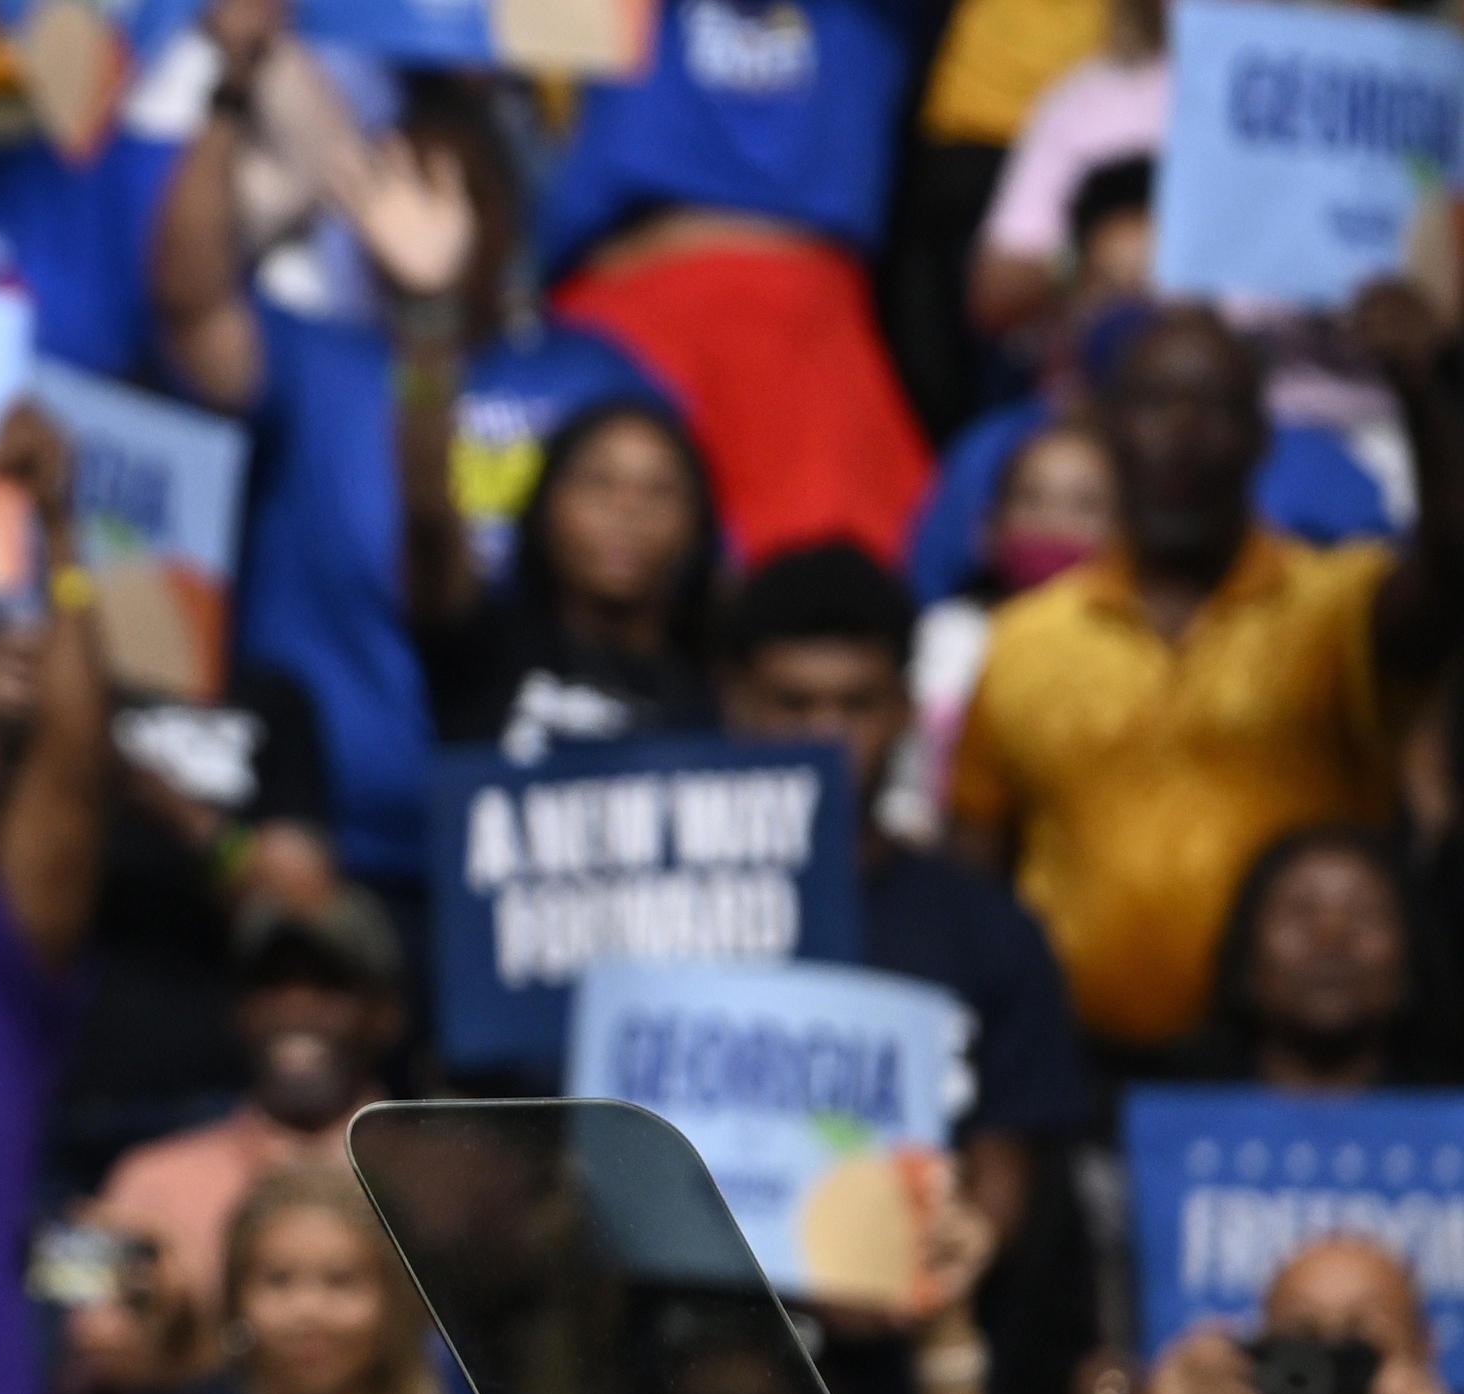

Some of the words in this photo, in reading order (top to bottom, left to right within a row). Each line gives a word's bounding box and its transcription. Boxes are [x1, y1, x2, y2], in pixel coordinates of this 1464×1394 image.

[463, 786, 517, 893] A
[522, 775, 662, 880] NEW
[675, 766, 820, 868] WAY
[608, 1008, 904, 1124] GEORGIA
